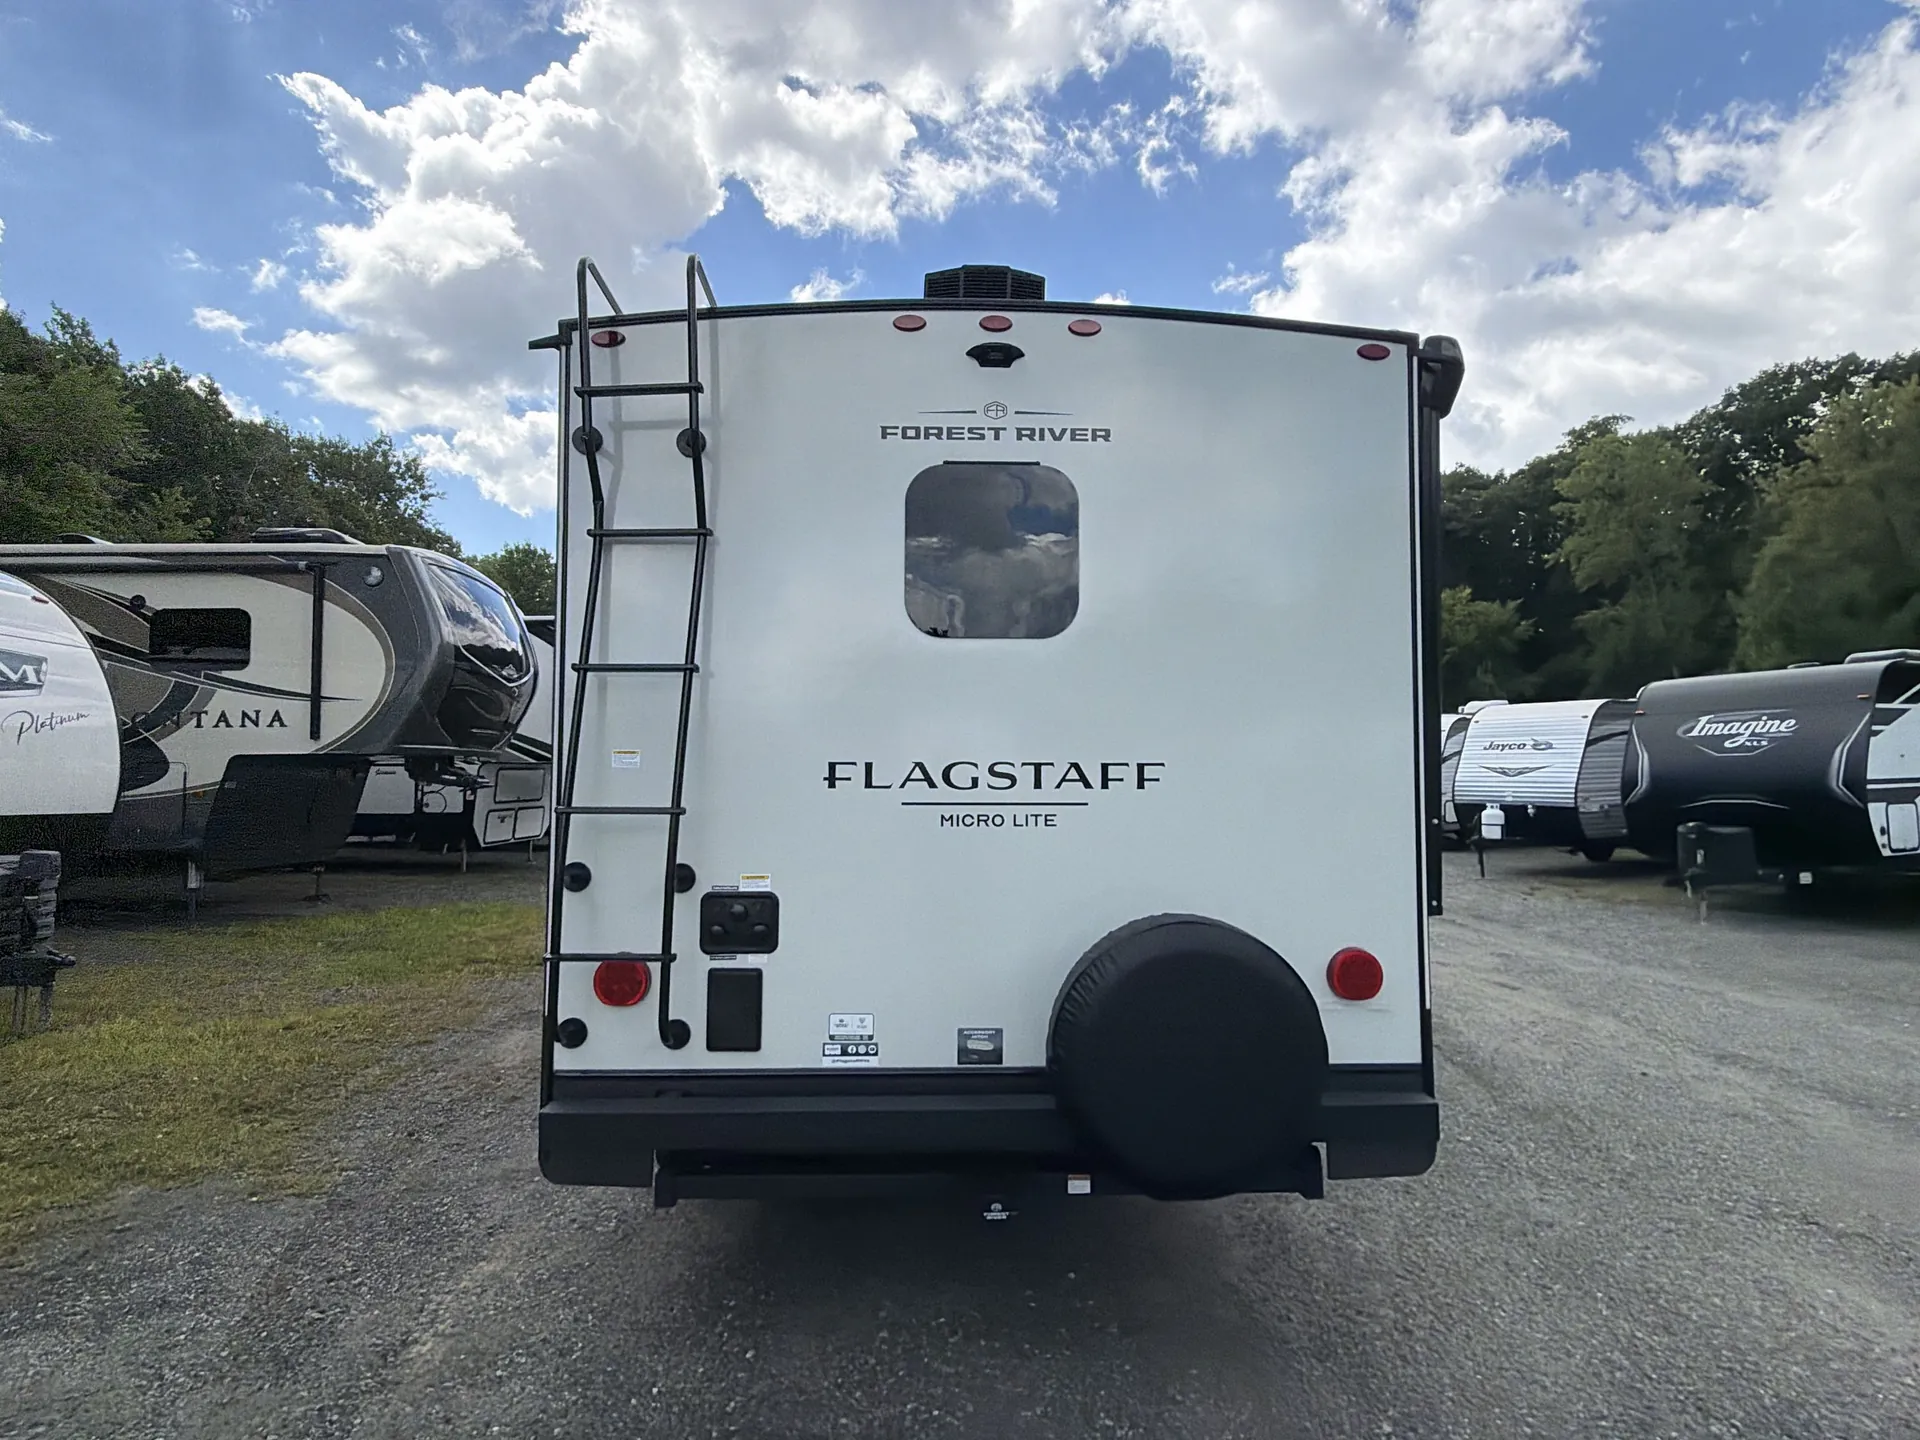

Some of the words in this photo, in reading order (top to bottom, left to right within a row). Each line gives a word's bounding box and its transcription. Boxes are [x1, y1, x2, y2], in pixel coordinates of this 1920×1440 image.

[880, 425, 1007, 441] FOREST
[1015, 426, 1112, 442] RIVER
[1, 709, 90, 745] Platinum
[1685, 714, 1799, 748] Imagine
[1483, 741, 1527, 752] Jayco
[823, 761, 1165, 790] FLAGSTAFF
[940, 814, 1005, 827] MICRO
[1013, 814, 1057, 827] LITE
